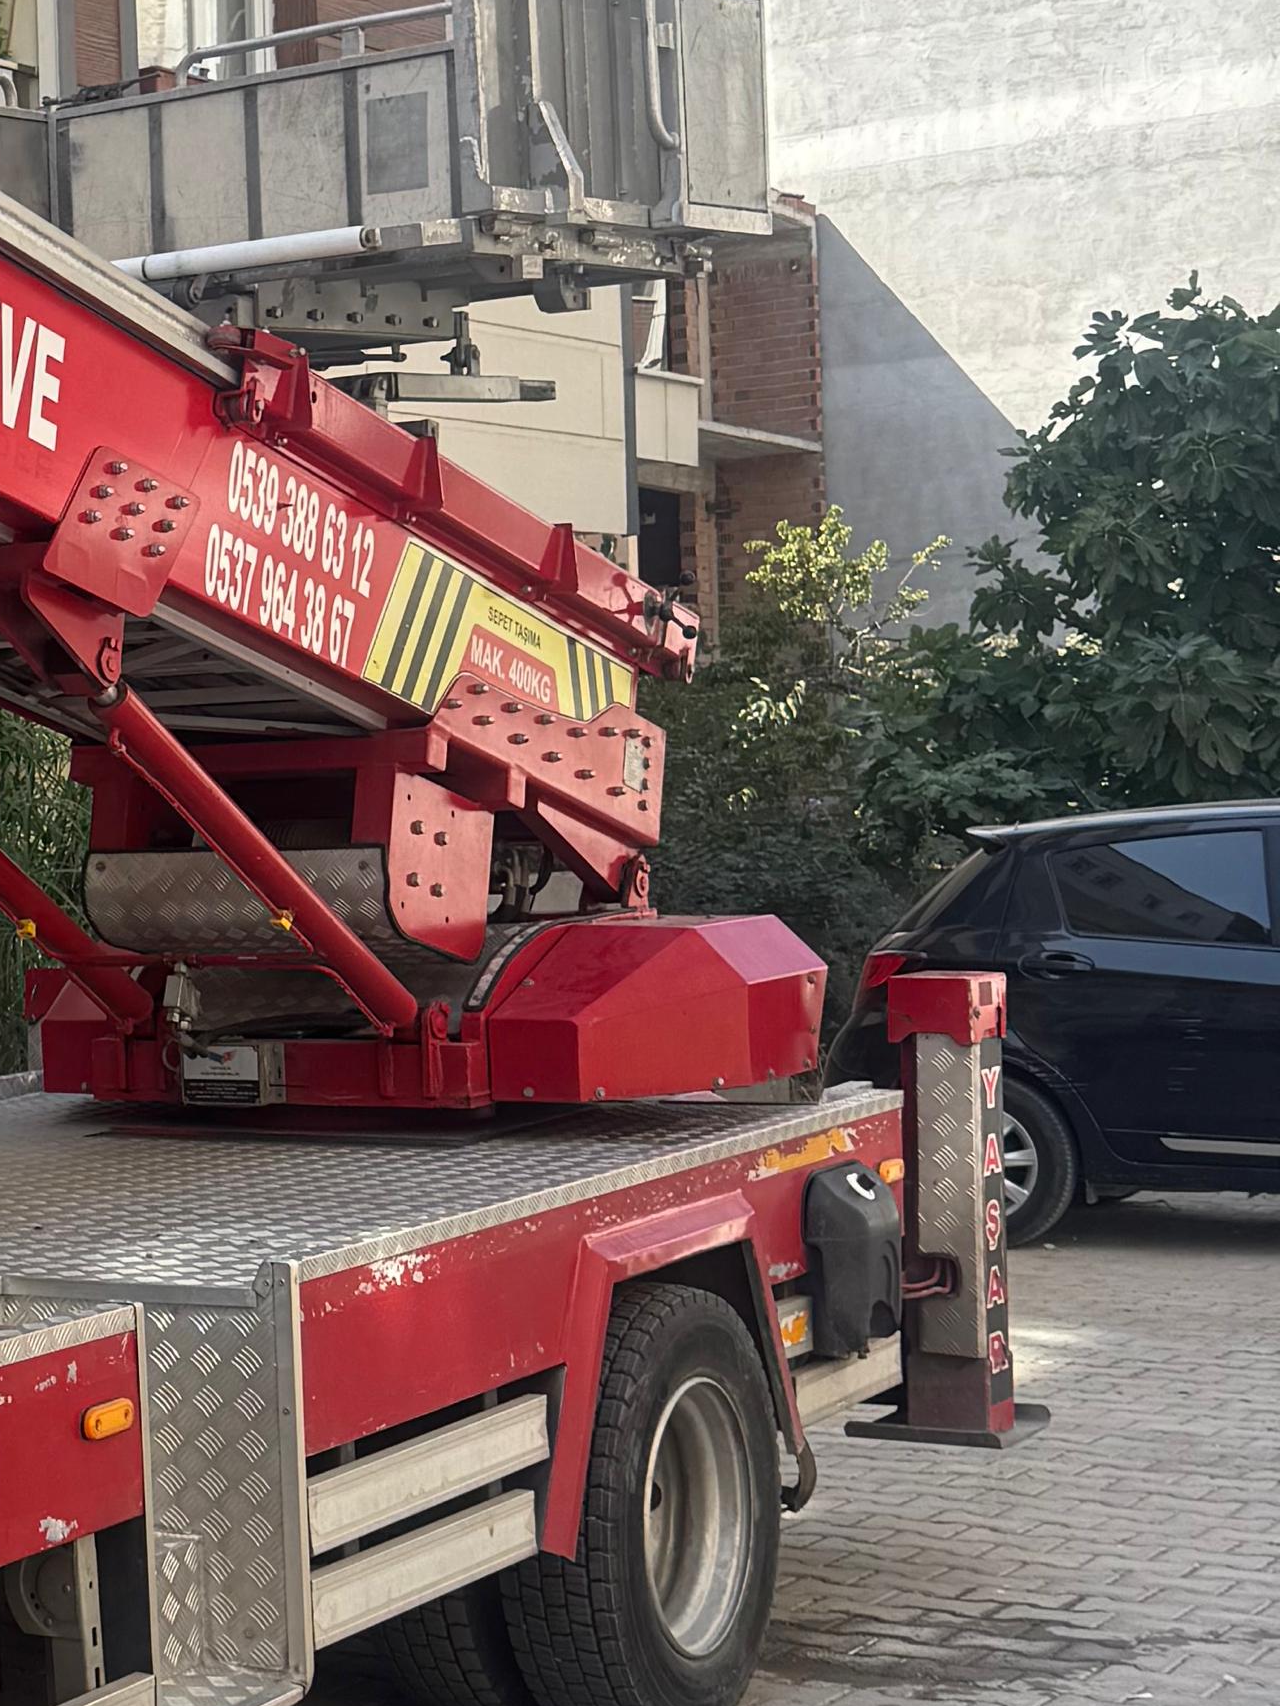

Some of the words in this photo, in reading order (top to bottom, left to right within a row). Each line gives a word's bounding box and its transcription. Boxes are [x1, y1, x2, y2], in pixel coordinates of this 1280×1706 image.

[228, 440, 279, 535] 0539
[281, 476, 320, 562] 388
[321, 503, 347, 580] 63
[351, 521, 375, 598] 12
[204, 523, 258, 616] 0537
[259, 554, 298, 640] 964
[300, 577, 326, 655] 38
[329, 593, 355, 669] 67
[487, 606, 513, 633] SEPET
[470, 635, 506, 679] MAK.
[508, 657, 551, 704] 400KG
